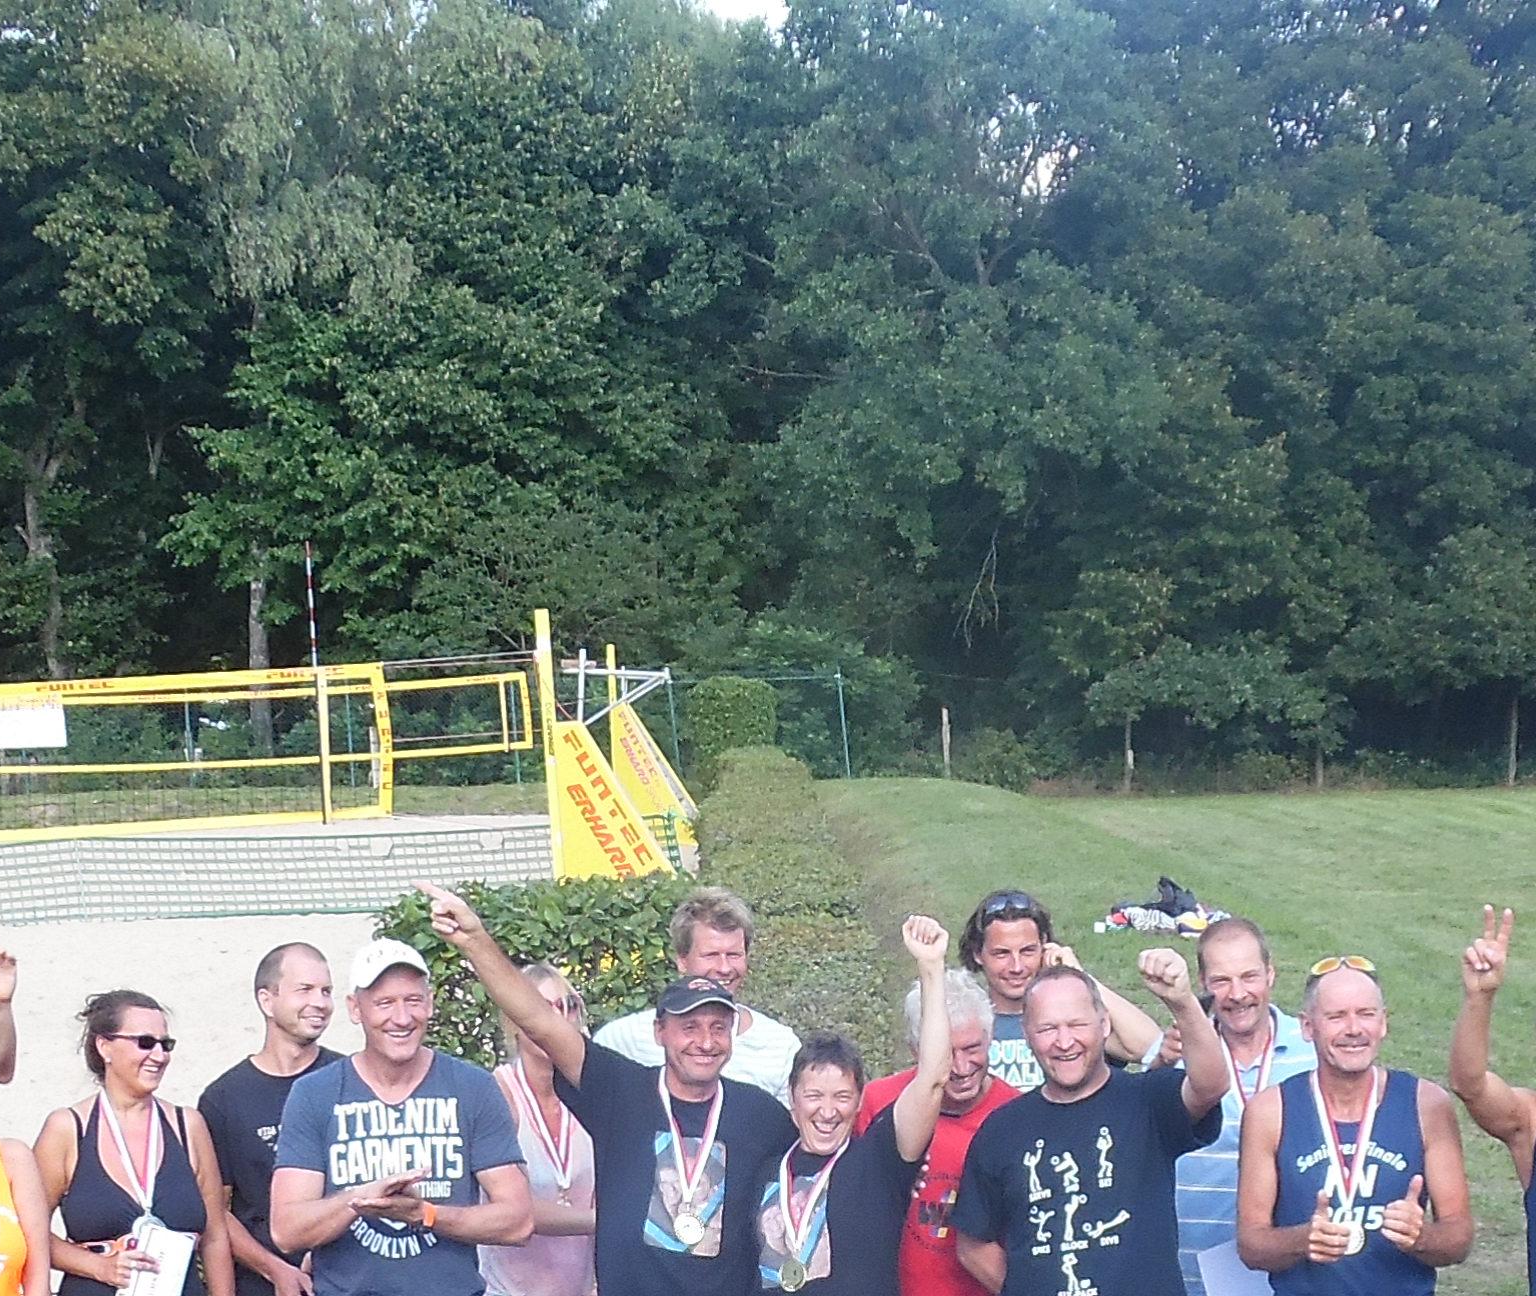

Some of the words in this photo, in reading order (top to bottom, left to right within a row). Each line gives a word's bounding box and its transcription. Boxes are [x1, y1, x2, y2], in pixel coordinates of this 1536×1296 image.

[563, 730, 653, 866] FUNTEC
[329, 1136, 464, 1186] GARMENTS
[349, 1215, 422, 1259] BROOKLYN
